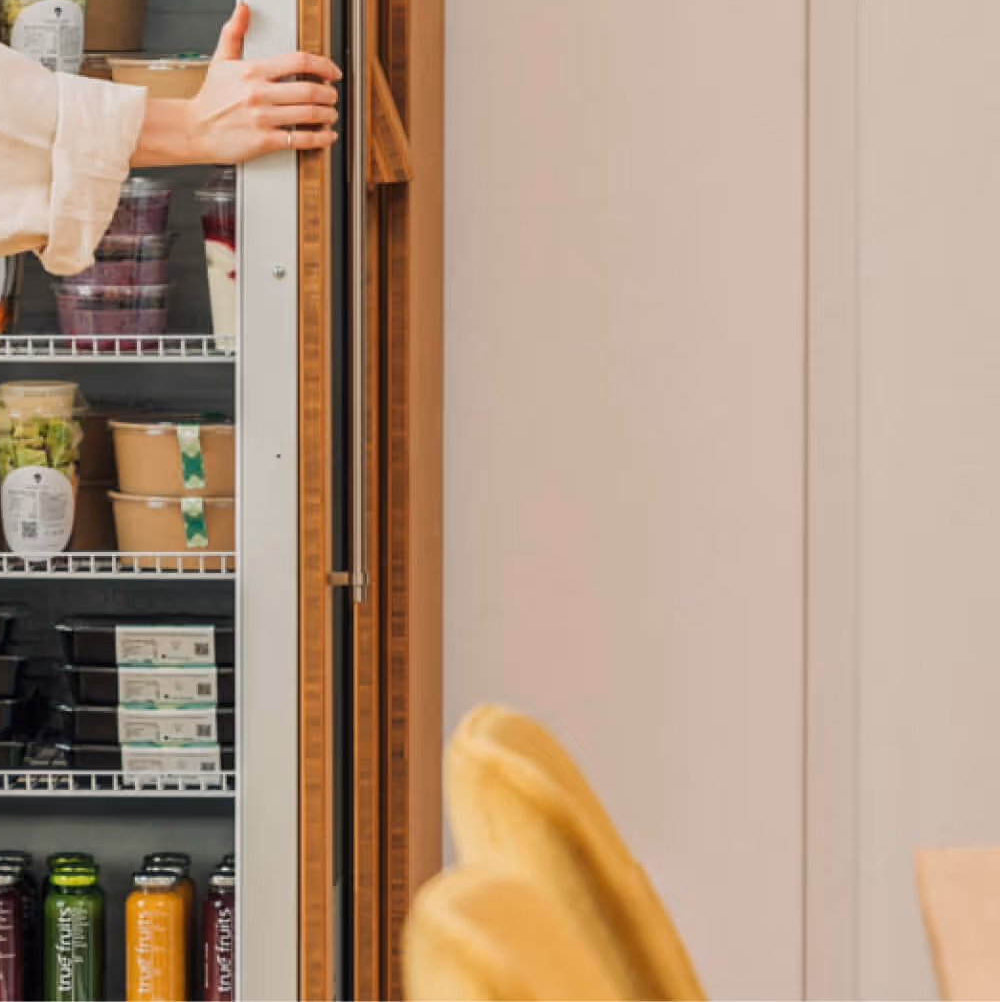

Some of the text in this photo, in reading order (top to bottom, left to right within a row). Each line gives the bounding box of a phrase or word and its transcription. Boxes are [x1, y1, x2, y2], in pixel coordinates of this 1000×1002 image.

[56, 906, 72, 992] true fruits
[214, 907, 232, 952] fruits
